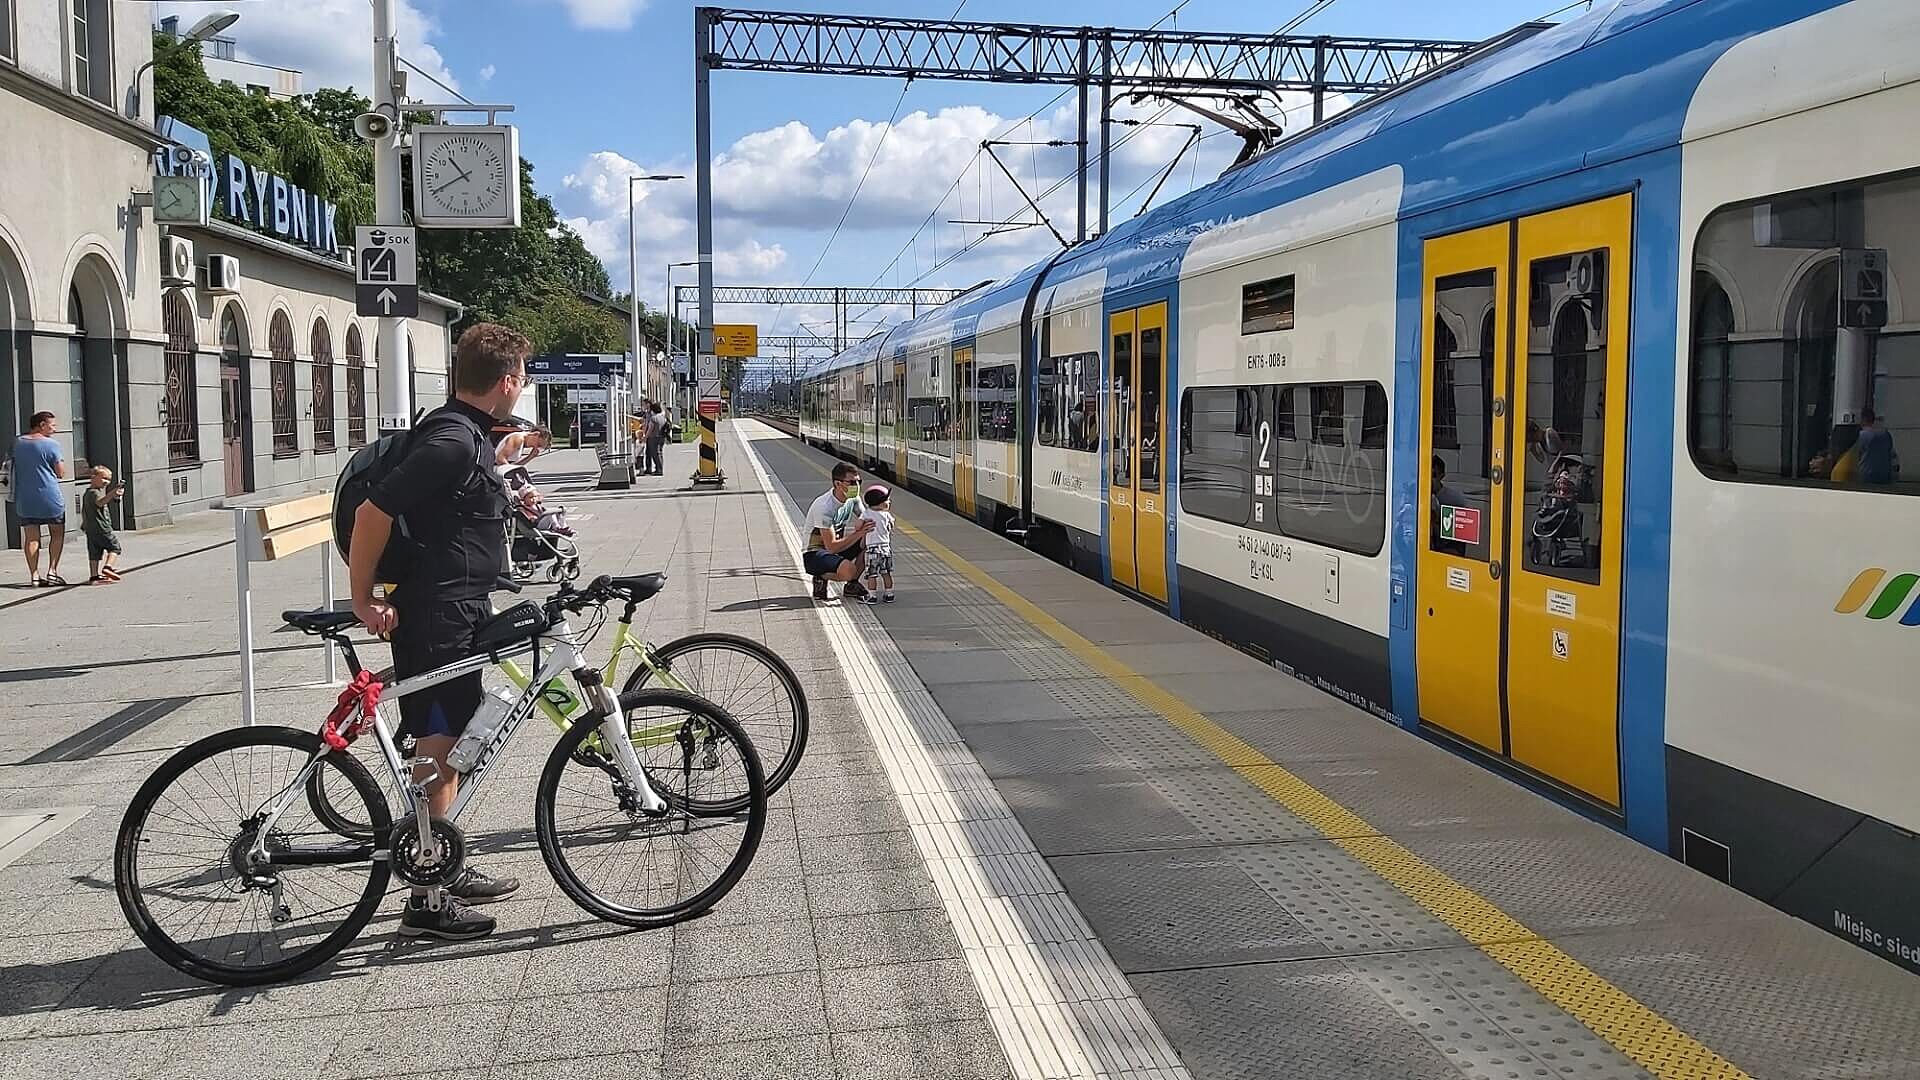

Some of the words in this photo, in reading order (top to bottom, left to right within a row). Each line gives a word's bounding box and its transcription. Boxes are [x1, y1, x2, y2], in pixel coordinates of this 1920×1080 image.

[438, 159, 447, 167] 10
[226, 153, 340, 254] RYBNIK
[388, 236, 410, 245] SOK
[1258, 420, 1271, 469] 2
[1250, 559, 1275, 582] PL-KSL
[1834, 910, 1882, 947] Miejsc
